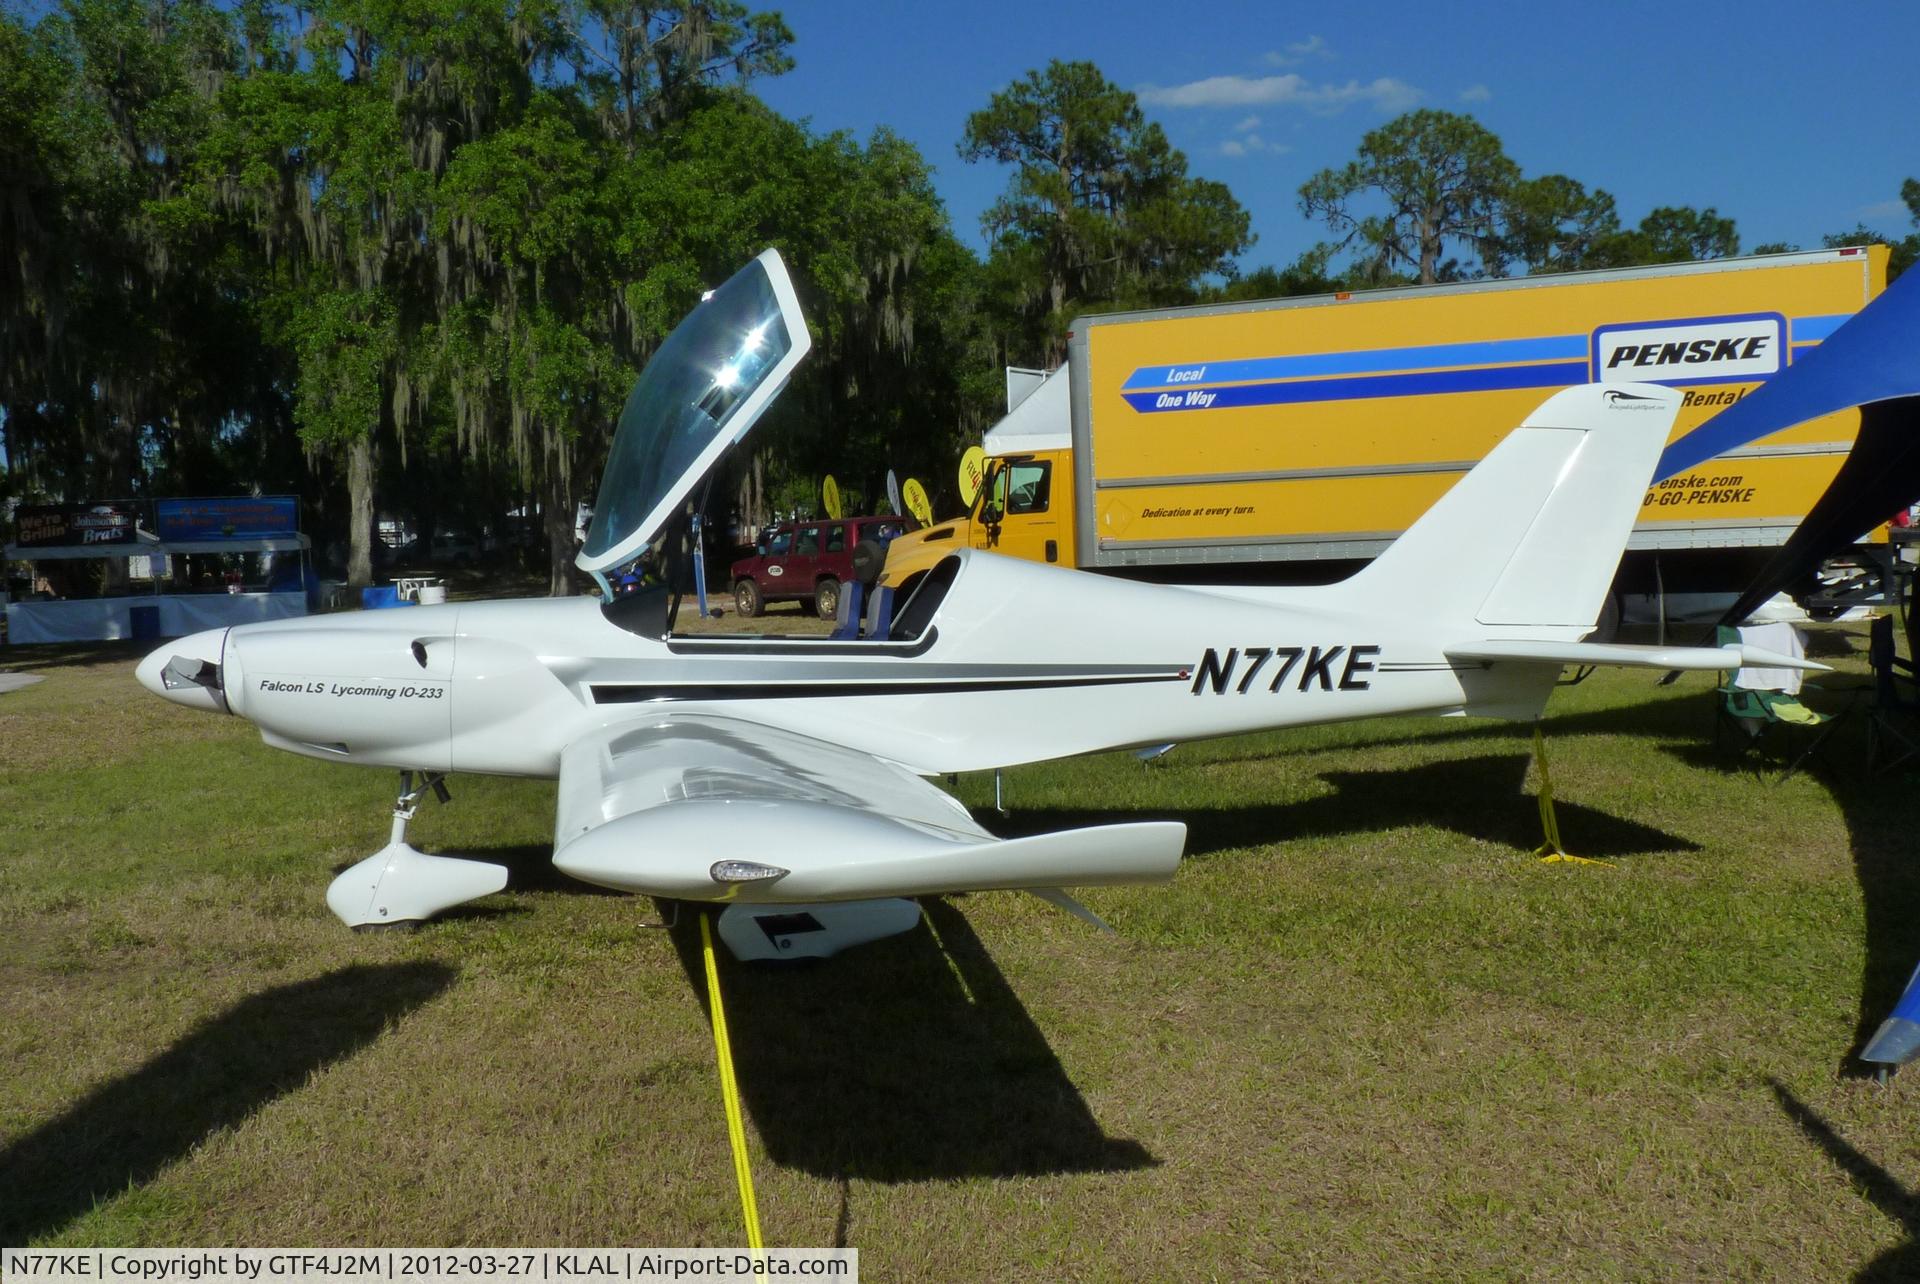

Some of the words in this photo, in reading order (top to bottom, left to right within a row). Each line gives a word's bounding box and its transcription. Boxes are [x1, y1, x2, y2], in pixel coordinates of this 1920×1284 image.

[1607, 336, 1771, 368] PENSKE
[1166, 366, 1206, 383] Local
[1156, 393, 1183, 408] One
[1185, 391, 1217, 407] Way
[1681, 388, 1746, 407] Rental
[1650, 474, 1743, 489] enske.com
[1142, 507, 1191, 518] Dedication
[1193, 507, 1203, 516] at
[1205, 506, 1232, 517] every
[1234, 505, 1256, 514] turn.
[20, 513, 61, 529] We're
[75, 515, 129, 527] Johnsonville
[83, 528, 124, 544] Brats
[1191, 645, 1382, 696] N77KE
[260, 680, 302, 693] Falcon
[306, 682, 324, 693] LS
[331, 683, 396, 699] Lycoming
[399, 686, 443, 699] IO-233
